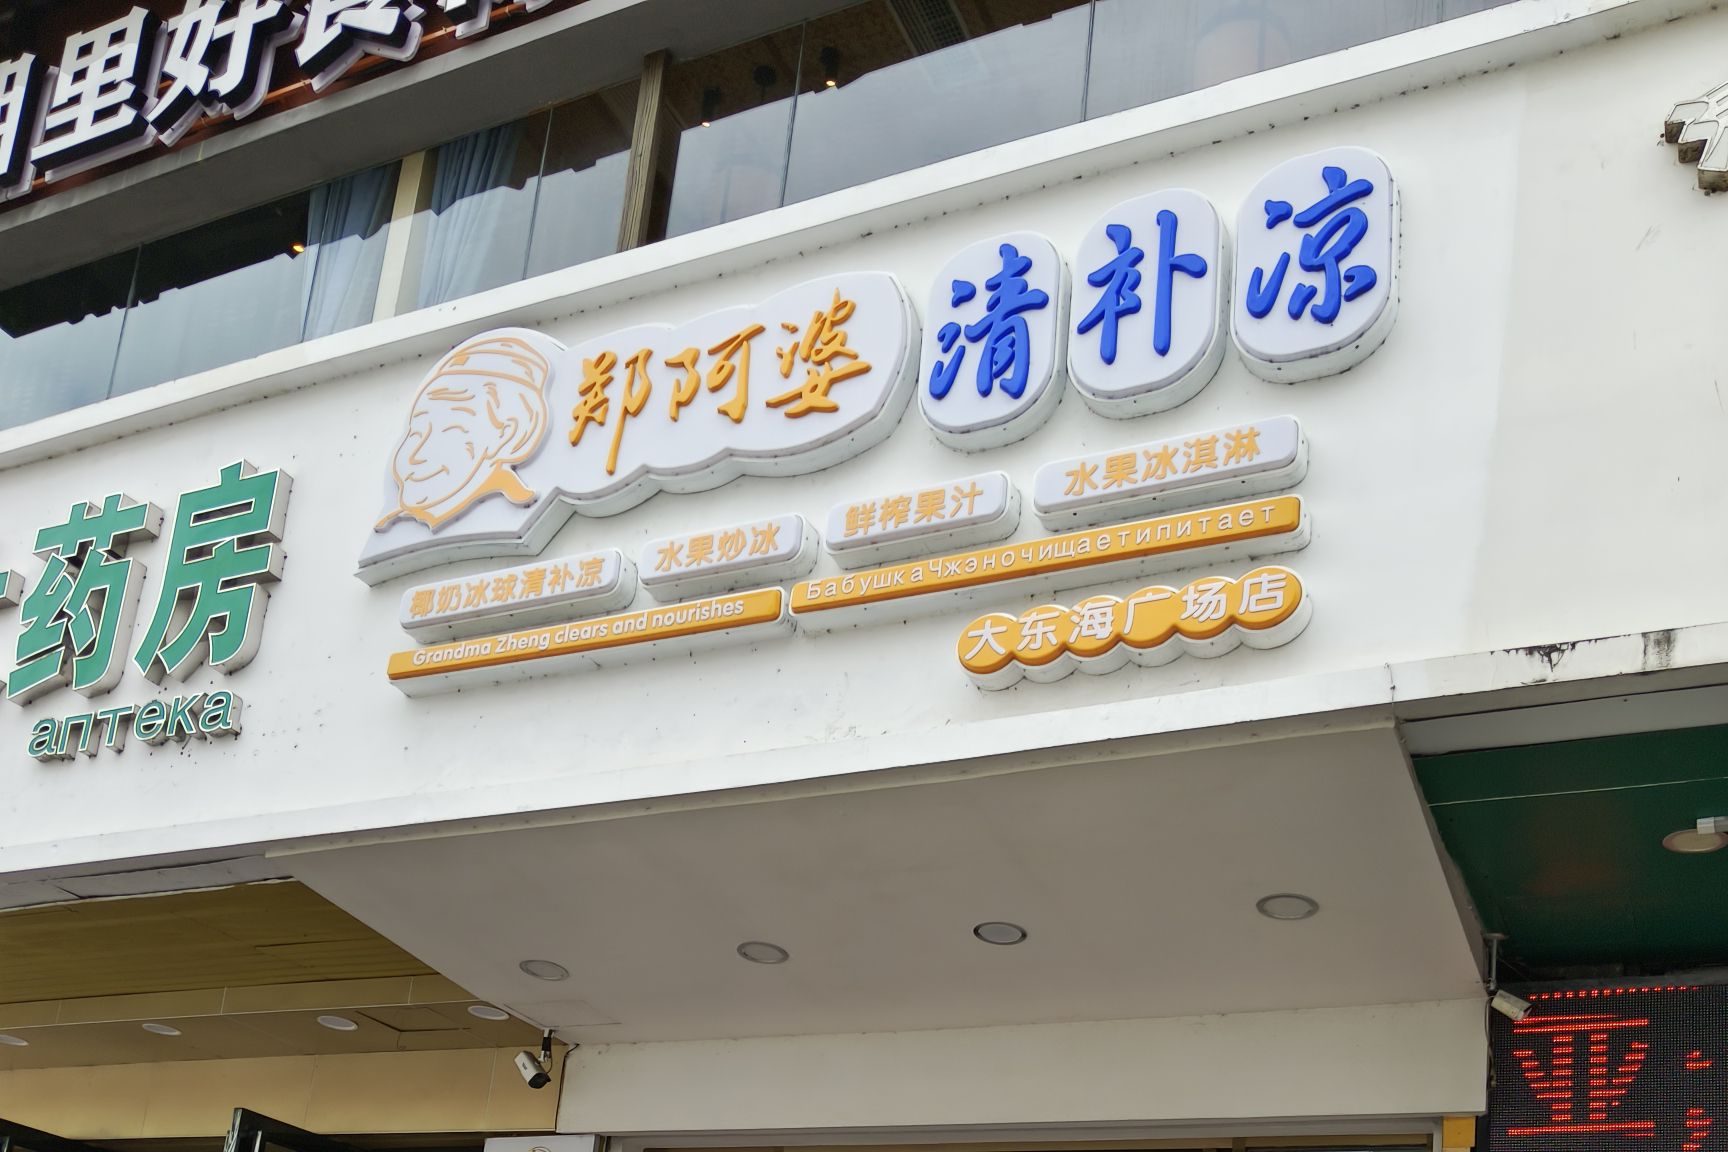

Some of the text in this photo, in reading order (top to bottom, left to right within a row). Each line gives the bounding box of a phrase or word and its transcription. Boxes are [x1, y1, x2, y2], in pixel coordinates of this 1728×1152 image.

[569, 165, 1379, 476] 郑阿婆 清补凉
[1063, 426, 1262, 497] 水果冰淇淋
[844, 484, 984, 538] 鲜榨果汁
[0, 458, 281, 699] 药房
[654, 522, 782, 573] 水果炒冰
[409, 557, 606, 619] 椰奶冰球清补凉
[965, 572, 1288, 660] 大东海广场店
[412, 598, 745, 666] Grandma Zheng clears and nourishes
[28, 690, 234, 757] аптека
